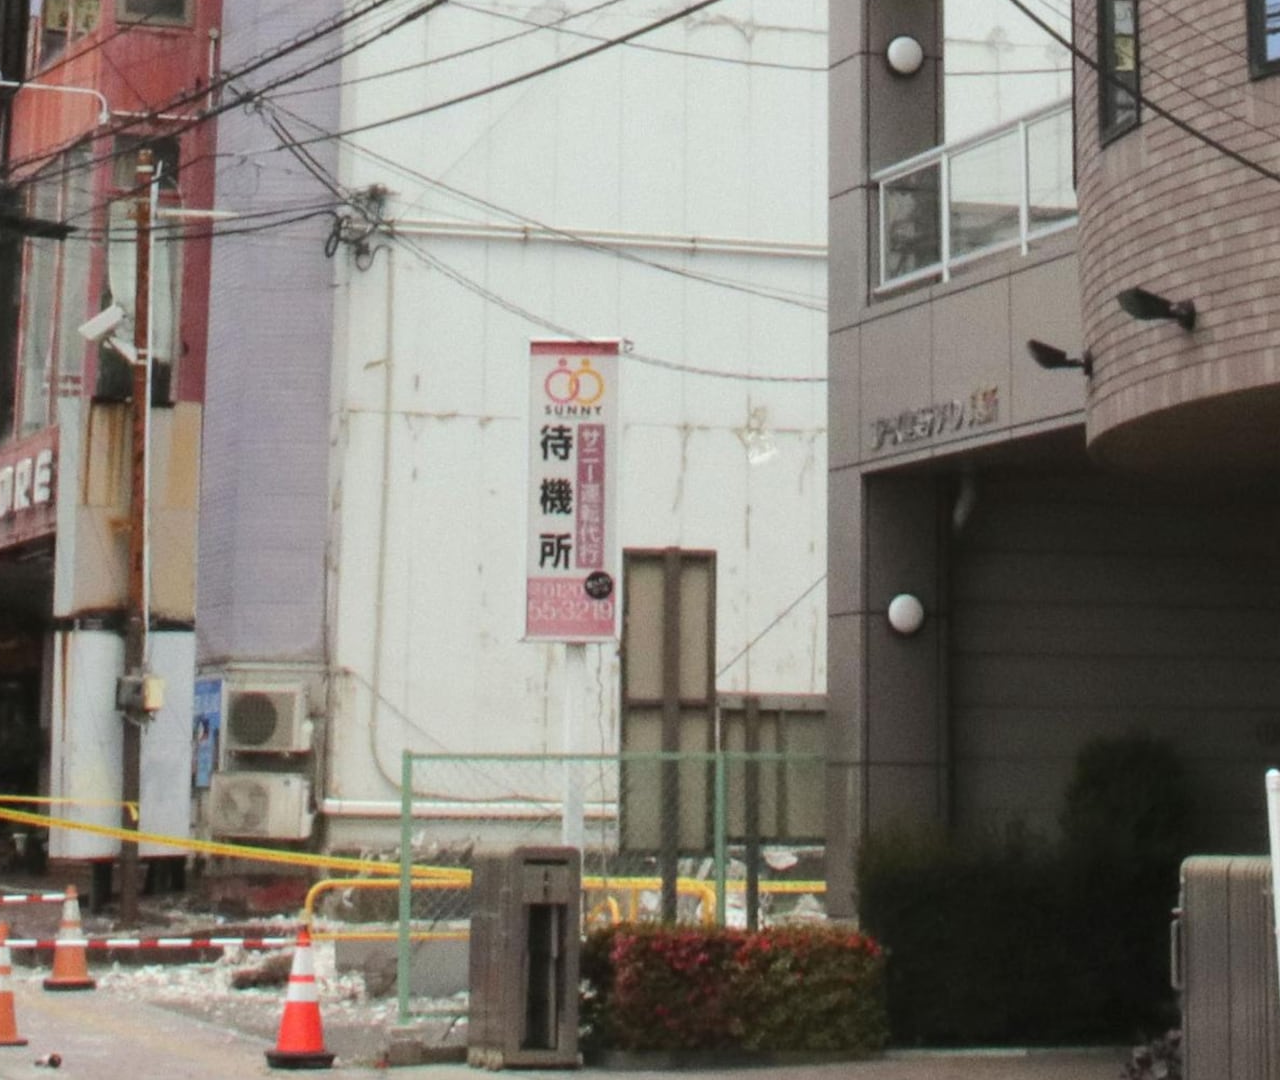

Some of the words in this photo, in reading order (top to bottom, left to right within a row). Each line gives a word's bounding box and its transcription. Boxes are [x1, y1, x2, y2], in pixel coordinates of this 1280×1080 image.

[544, 404, 603, 417] SUNNY
[539, 424, 573, 570] 待機所
